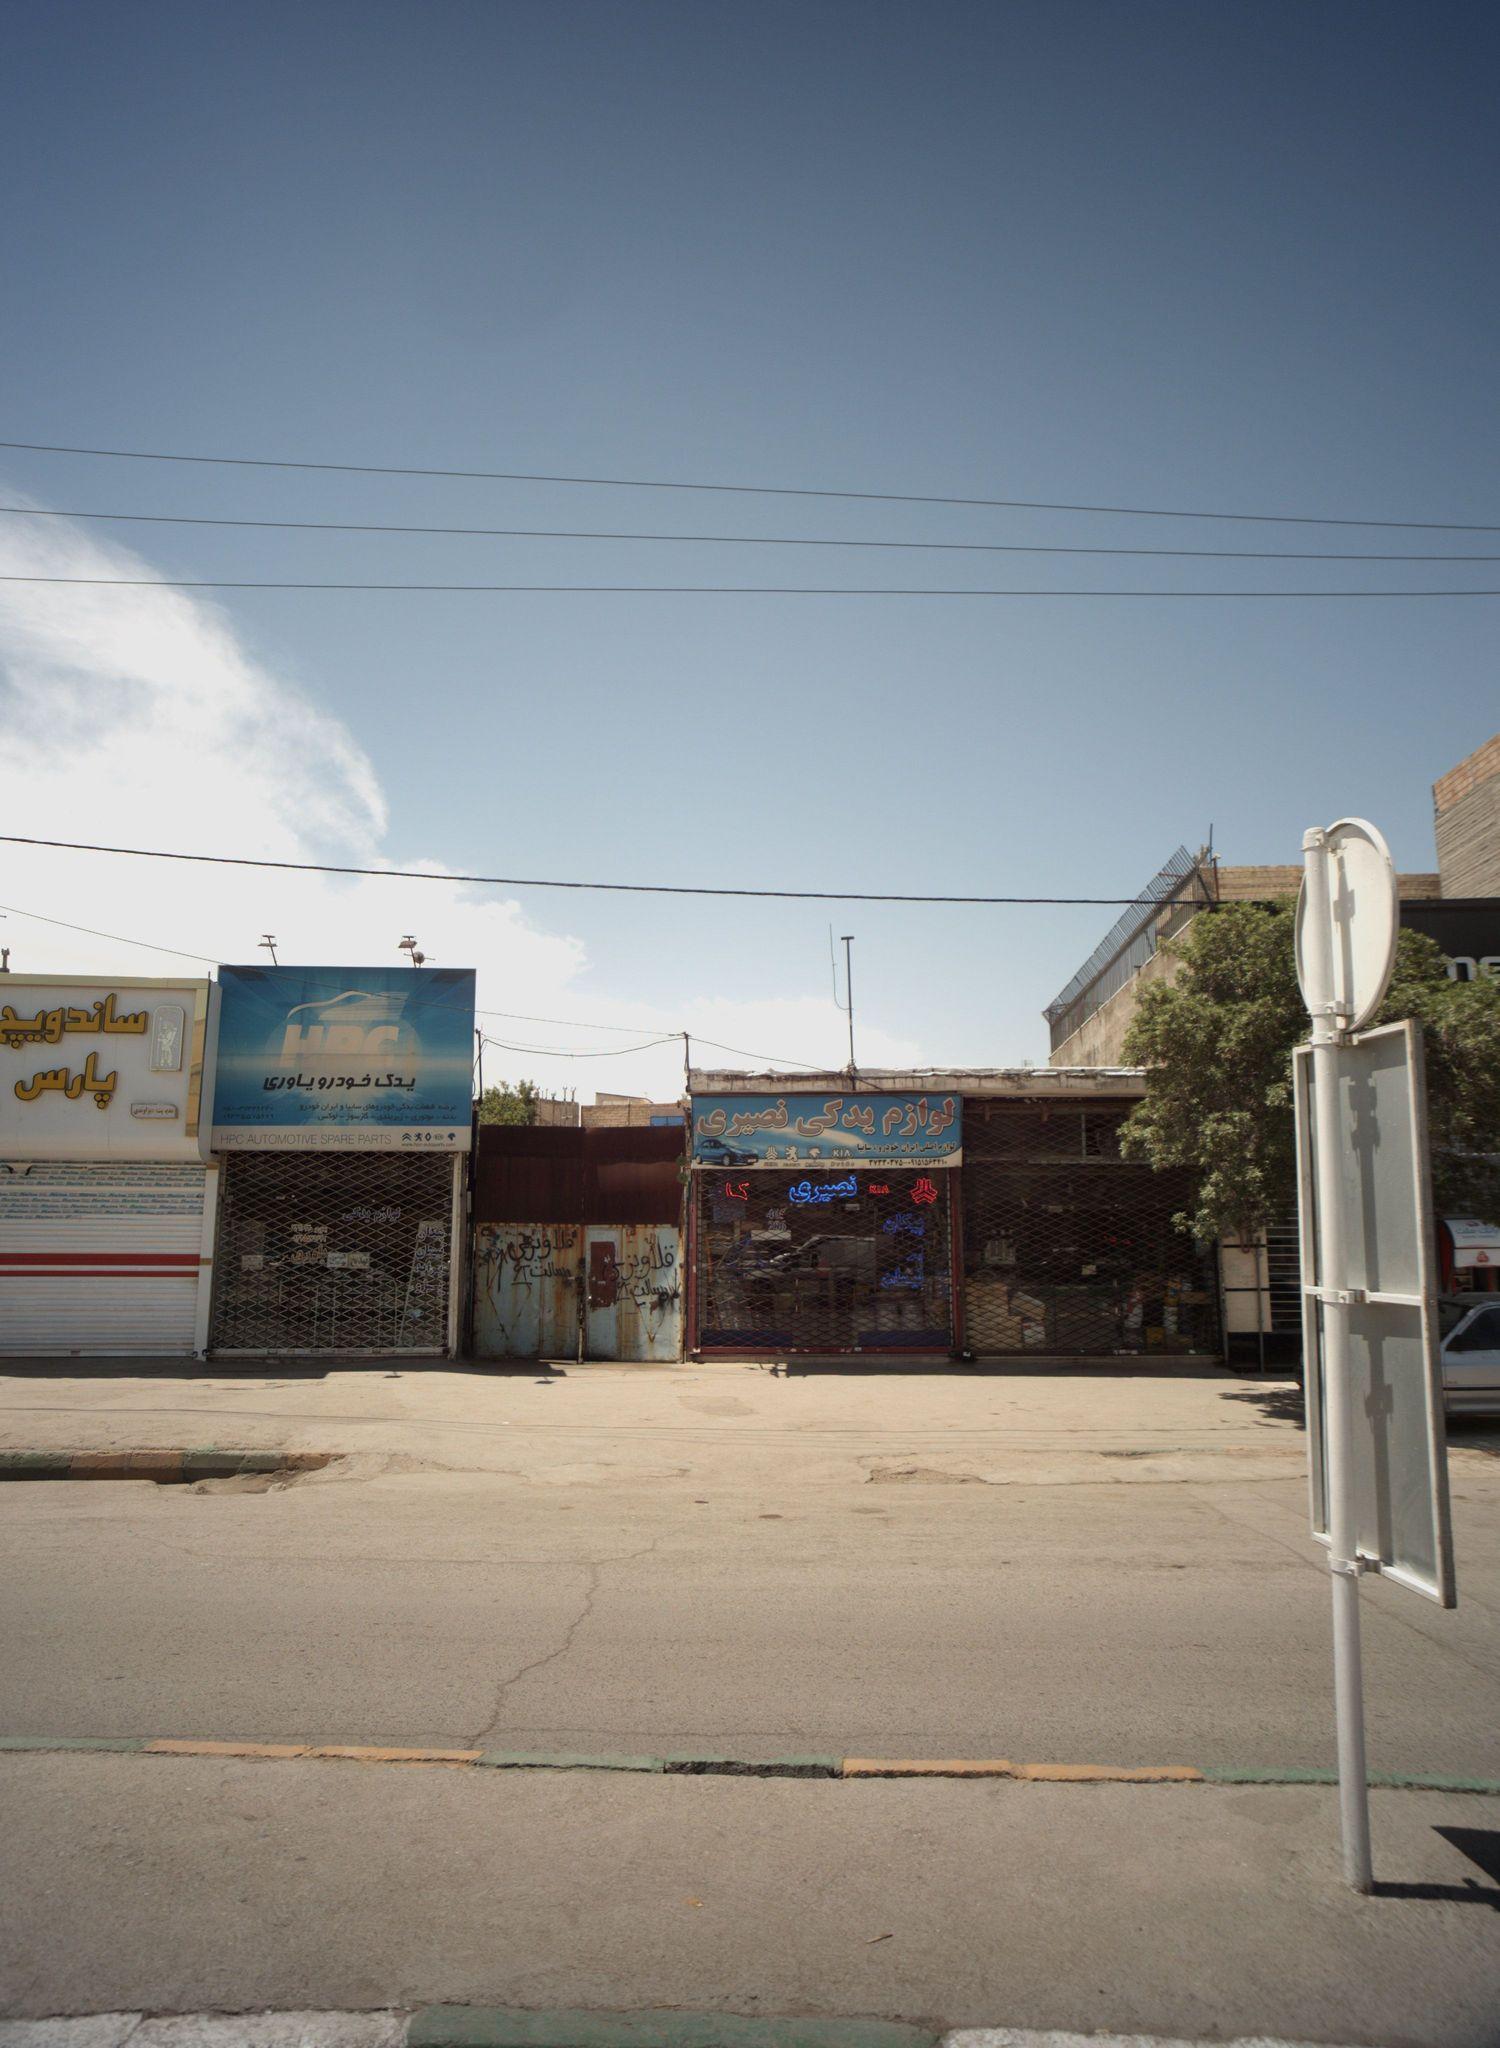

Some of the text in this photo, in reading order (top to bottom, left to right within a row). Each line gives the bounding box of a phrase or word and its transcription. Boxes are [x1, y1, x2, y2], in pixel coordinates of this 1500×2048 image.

[280, 1024, 400, 1067] HPC
[15, 1052, 117, 1109] پارس
[263, 1074, 416, 1091] یدک خودرو یاوری
[696, 1097, 957, 1137] لوازم یدکی نصیری
[220, 1134, 392, 1145] HPC AUTOMOTIVE SPARE PARTS
[789, 1176, 858, 1203] نصیری
[868, 1184, 890, 1194] KIA
